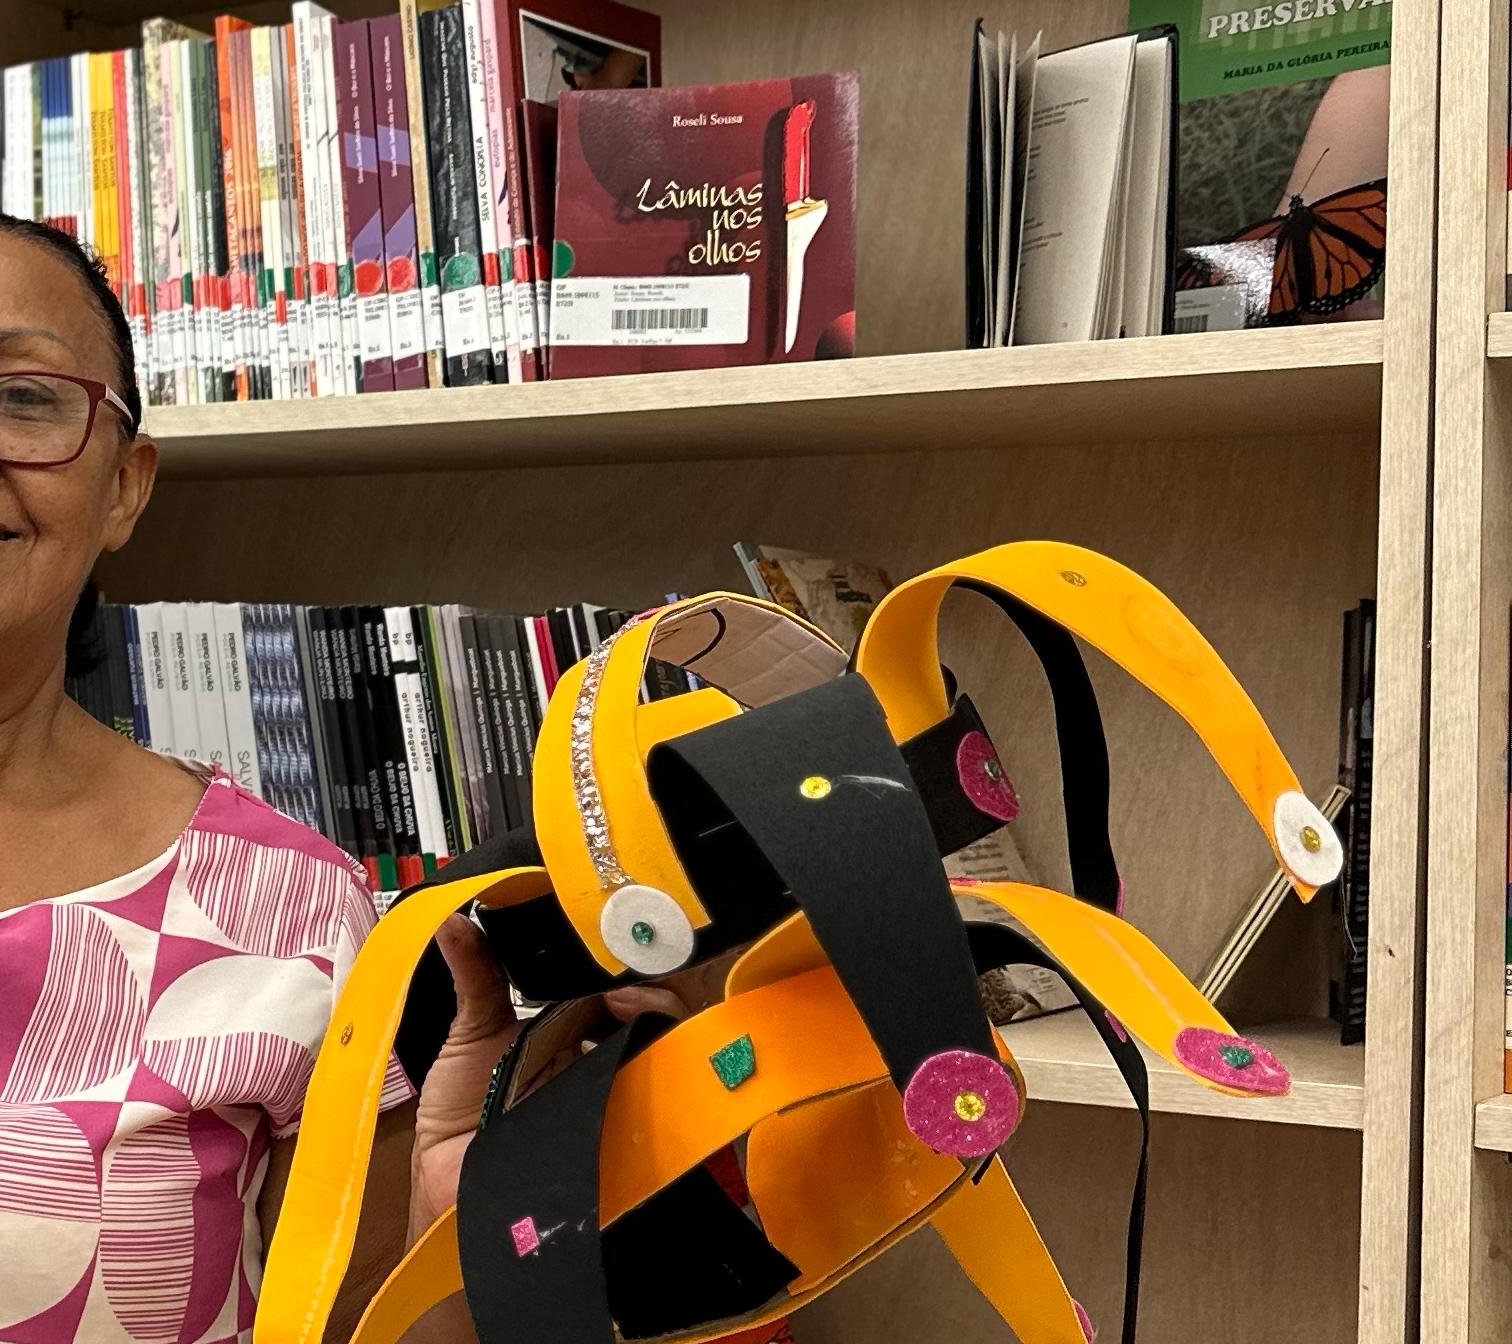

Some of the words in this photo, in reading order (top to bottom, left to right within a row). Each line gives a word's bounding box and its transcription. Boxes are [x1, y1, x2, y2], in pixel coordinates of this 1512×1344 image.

[467, 25, 476, 61] augusto
[1224, 64, 1264, 80] MARIA
[1266, 59, 1285, 73] DA
[1287, 50, 1334, 70] GLÓRIA
[1336, 39, 1391, 61] PEREIRA
[486, 77, 496, 113] marcela
[504, 108, 514, 150] Adolescente
[672, 115, 706, 127] Roseli
[710, 113, 743, 125] Sousa
[509, 170, 519, 197] Criança
[636, 178, 763, 212] Lâminas
[479, 193, 490, 222] SELVA
[712, 207, 763, 231] nos
[688, 229, 762, 266] olhos
[150, 631, 160, 658] PEDRO
[175, 632, 185, 658] PEDRO
[200, 632, 210, 659] PEDRO
[227, 632, 237, 658] PEDRO
[376, 623, 387, 646] Wanda
[152, 658, 164, 689] GALVÃO
[177, 659, 189, 691] GALVÃO
[230, 659, 242, 692] GALVÃO
[379, 646, 391, 677] Monteiro
[202, 660, 215, 692] GALVÃO
[400, 692, 413, 724] arthur
[414, 692, 426, 724] arthur
[475, 697, 487, 724] Quiroga
[491, 698, 503, 725] Quiroga
[504, 700, 517, 726] Quiroga
[406, 727, 420, 772] nogueira
[419, 727, 434, 773] nogueira
[386, 768, 397, 791] BEIJO
[397, 762, 407, 770] O
[398, 770, 410, 793] BEIJO
[389, 792, 399, 805] DA
[402, 794, 412, 807] DA
[391, 805, 403, 833] CHUVA
[404, 807, 416, 836] CHUVA
